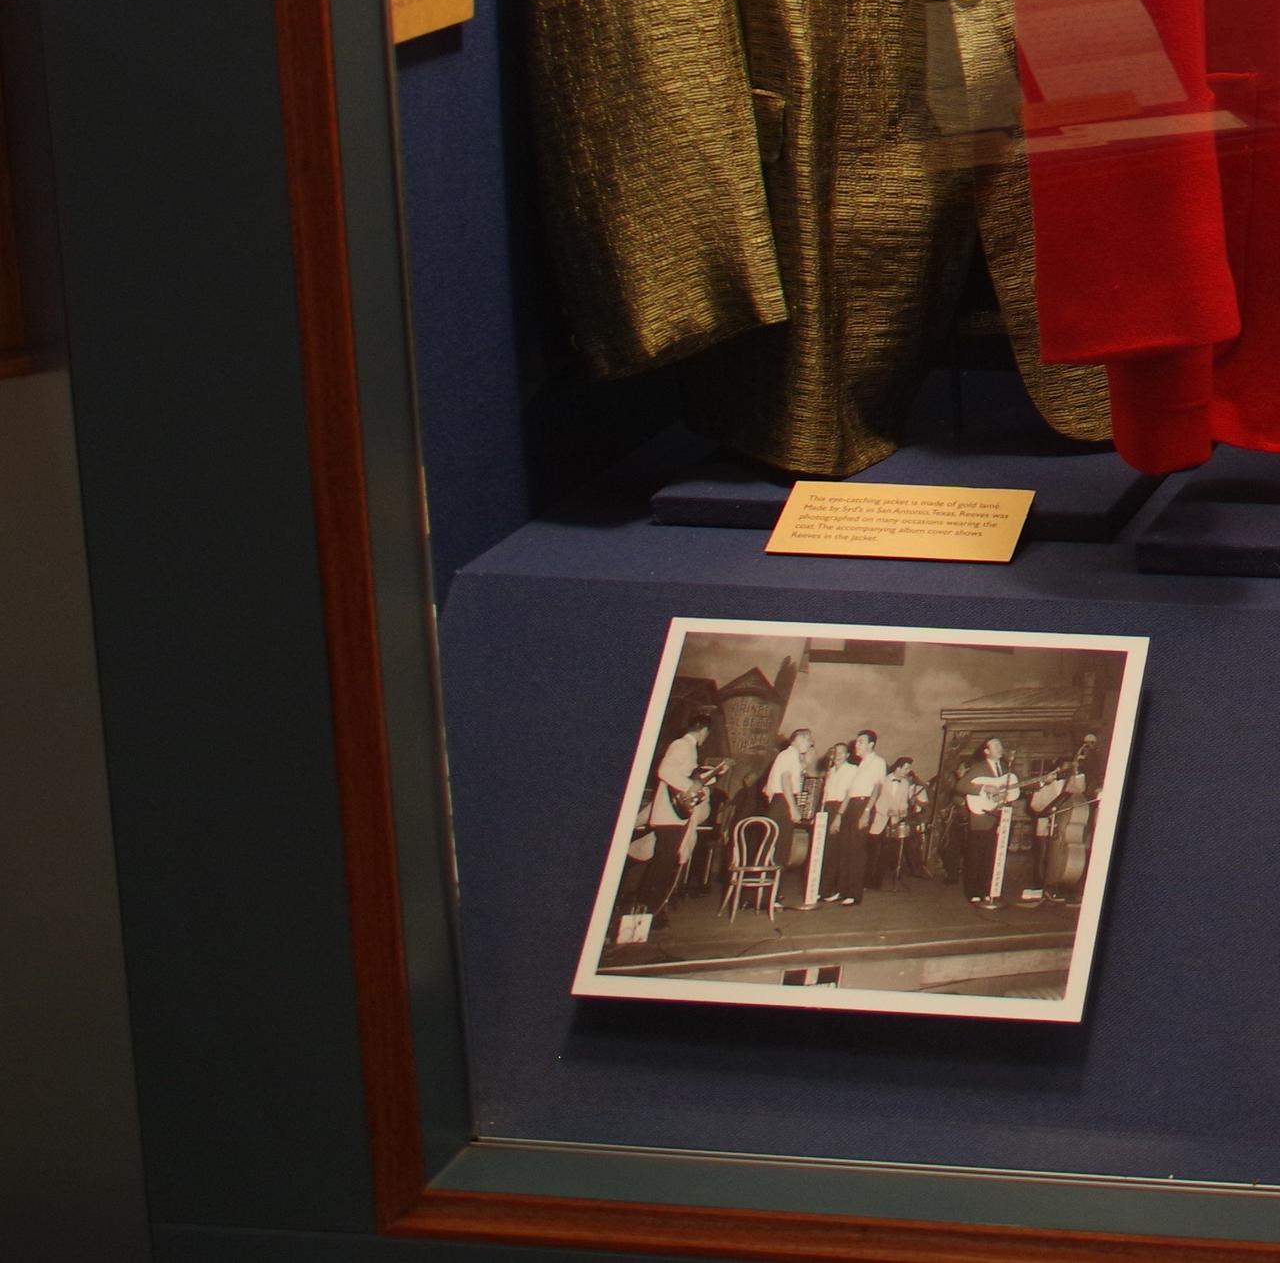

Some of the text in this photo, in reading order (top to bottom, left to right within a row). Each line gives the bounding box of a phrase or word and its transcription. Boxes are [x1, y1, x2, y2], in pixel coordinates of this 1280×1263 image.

[809, 494, 826, 502] This
[946, 500, 957, 508] of
[791, 531, 821, 539] Reeves
[834, 533, 849, 541] the
